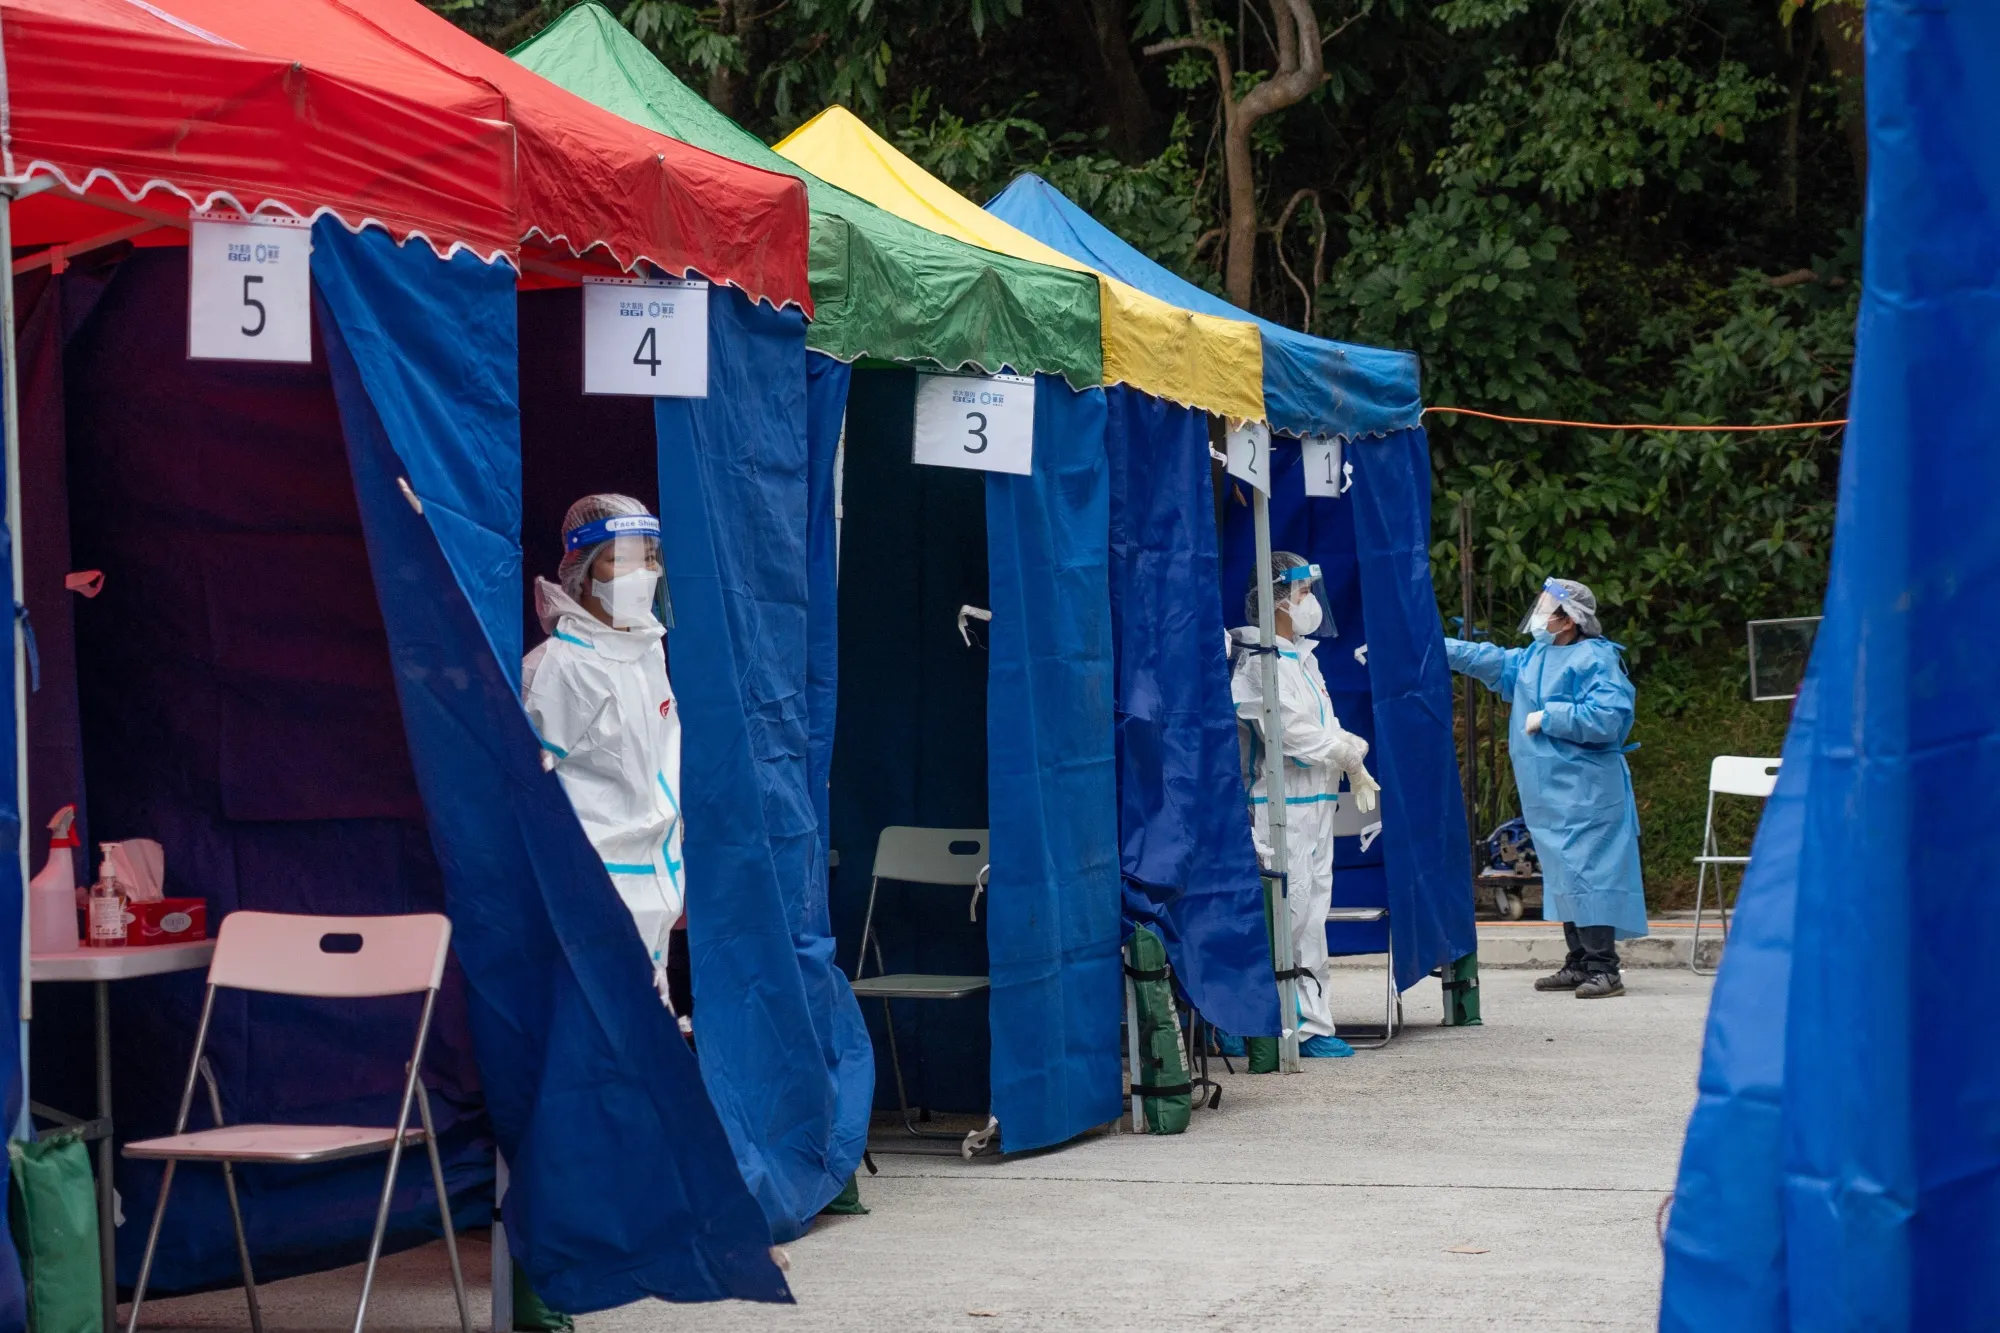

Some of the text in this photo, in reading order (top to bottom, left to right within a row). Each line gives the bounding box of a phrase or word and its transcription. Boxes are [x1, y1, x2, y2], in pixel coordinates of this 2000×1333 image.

[228, 253, 251, 262] BGI
[241, 275, 266, 337] 5
[633, 327, 662, 377] 4
[963, 411, 988, 454] 3
[1248, 439, 1258, 475] 2
[1324, 451, 1333, 484] 1
[614, 520, 635, 528] Face
